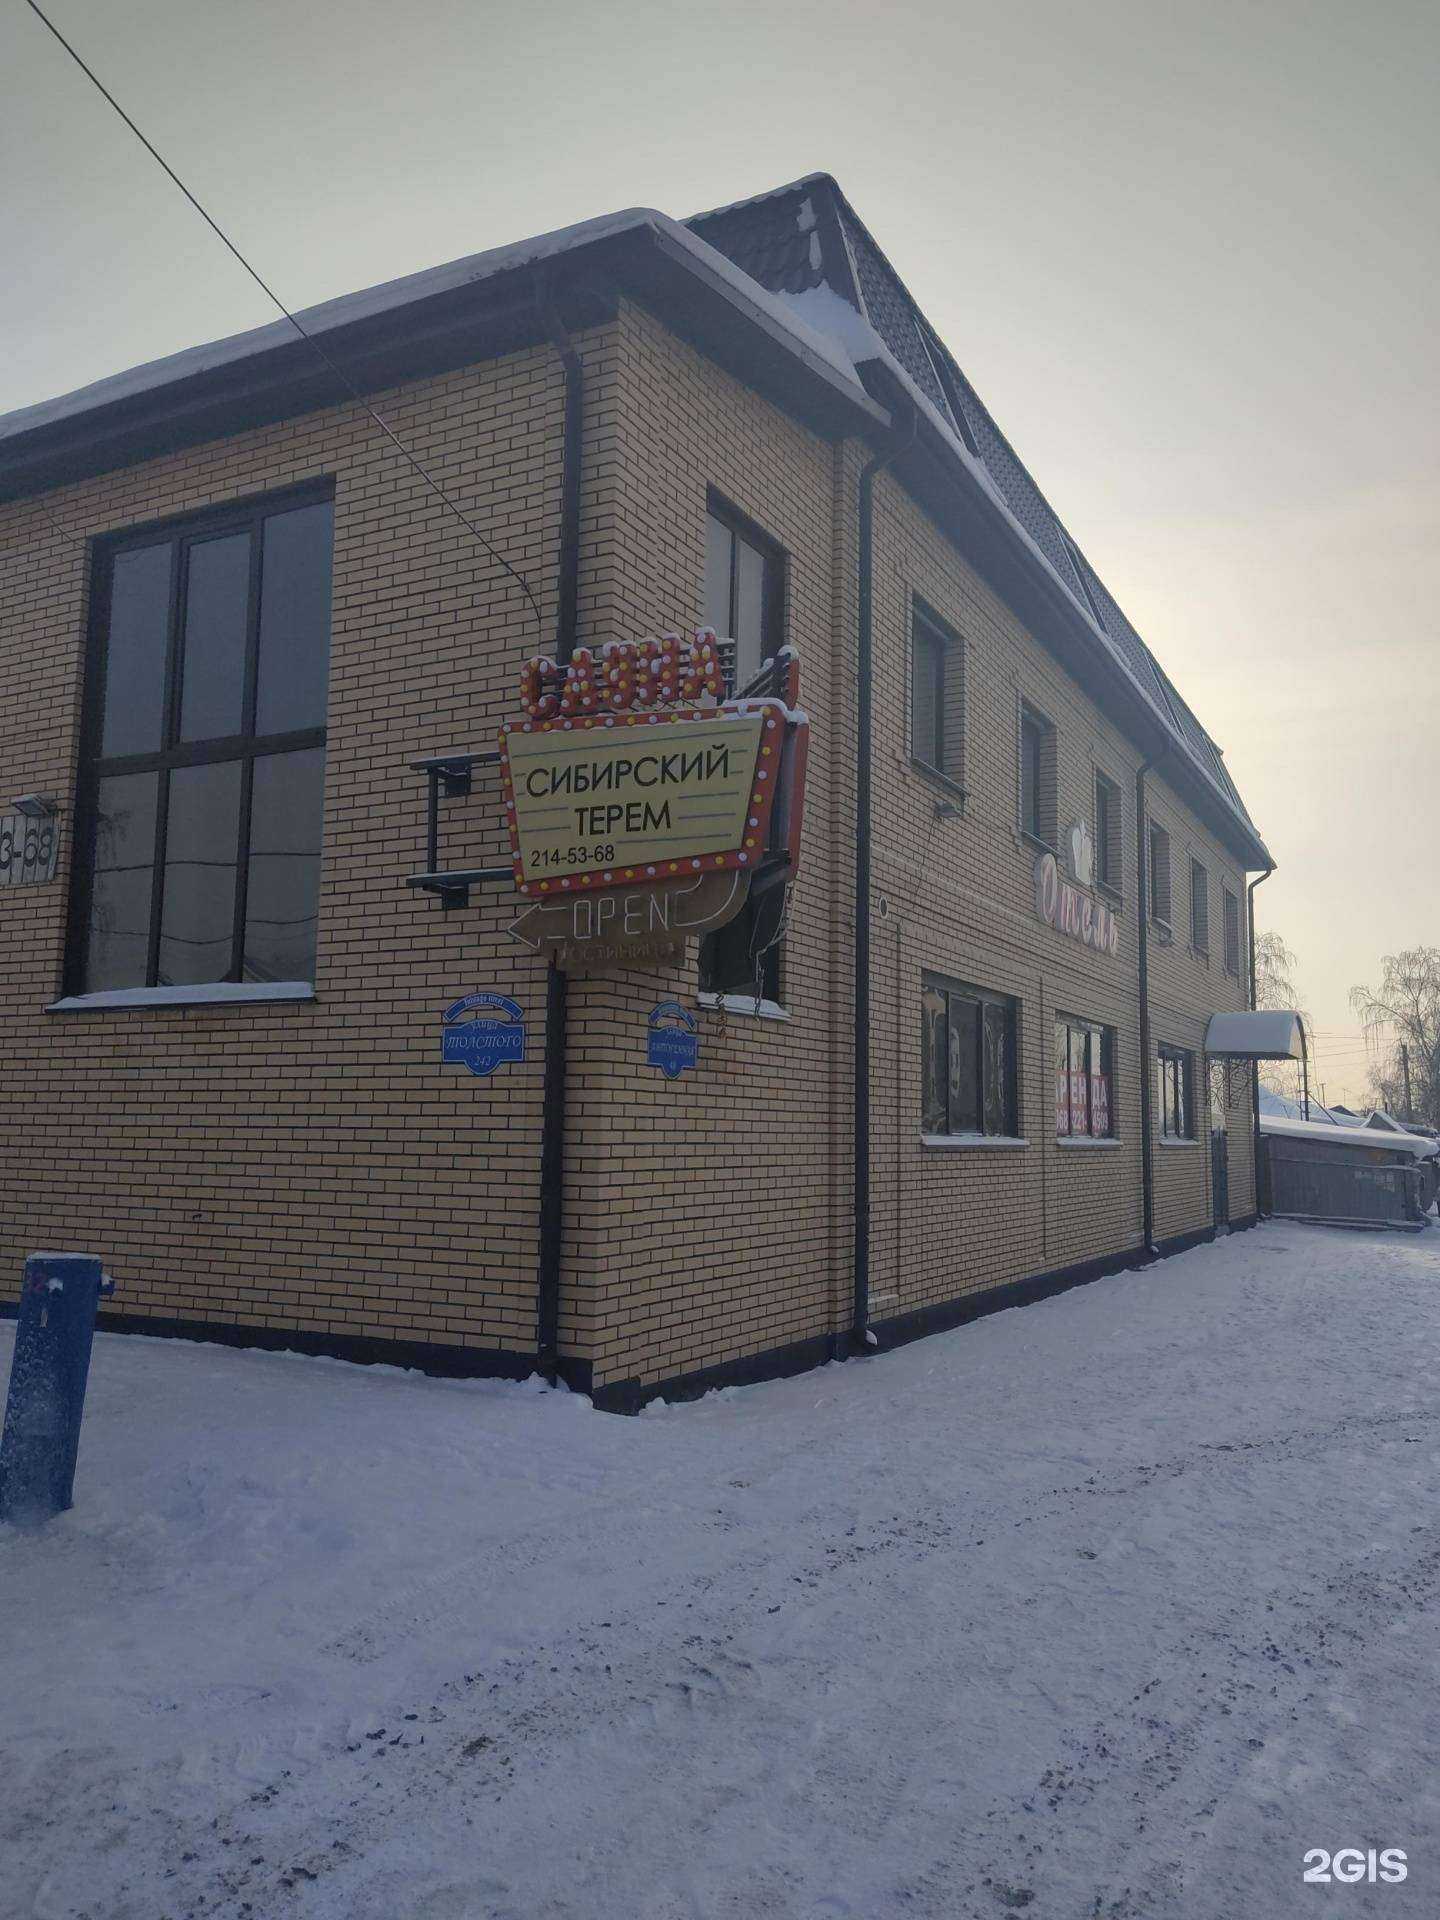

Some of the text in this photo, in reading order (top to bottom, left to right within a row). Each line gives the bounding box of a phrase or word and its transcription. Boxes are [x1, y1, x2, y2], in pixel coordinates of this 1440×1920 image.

[520, 627, 723, 720] САУНА
[526, 744, 728, 798] СИБИРСКИЙ
[574, 800, 671, 837] ТЕРЕМ
[531, 845, 615, 867] 214-53-68
[573, 893, 670, 939] OPEN
